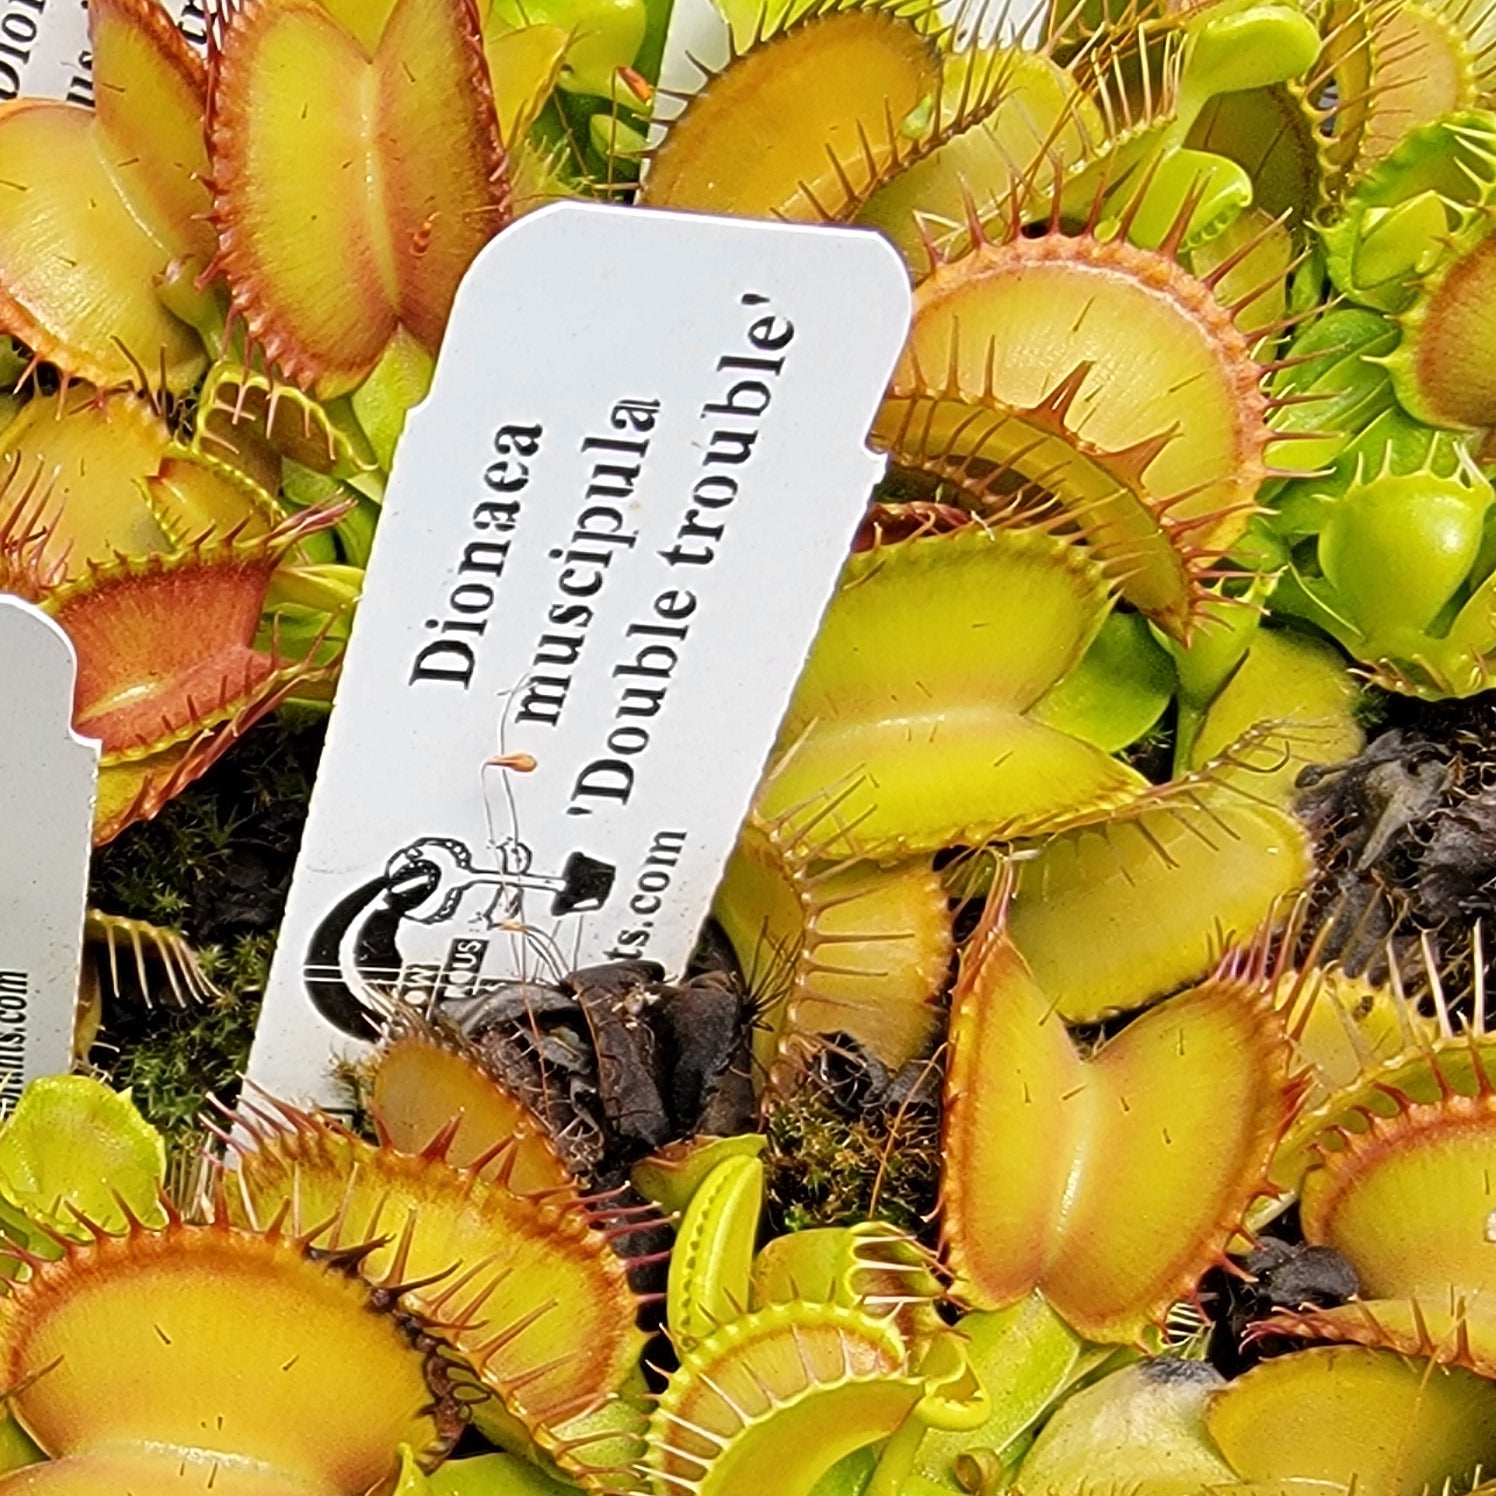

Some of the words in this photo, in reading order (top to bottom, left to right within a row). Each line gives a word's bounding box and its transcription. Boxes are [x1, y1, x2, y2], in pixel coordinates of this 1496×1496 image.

[409, 425, 543, 688] Dionaea
[514, 397, 663, 727] muscipula
[567, 590, 697, 815] 'Double
[660, 293, 795, 566] trouble'
[604, 832, 687, 967] ts.com
